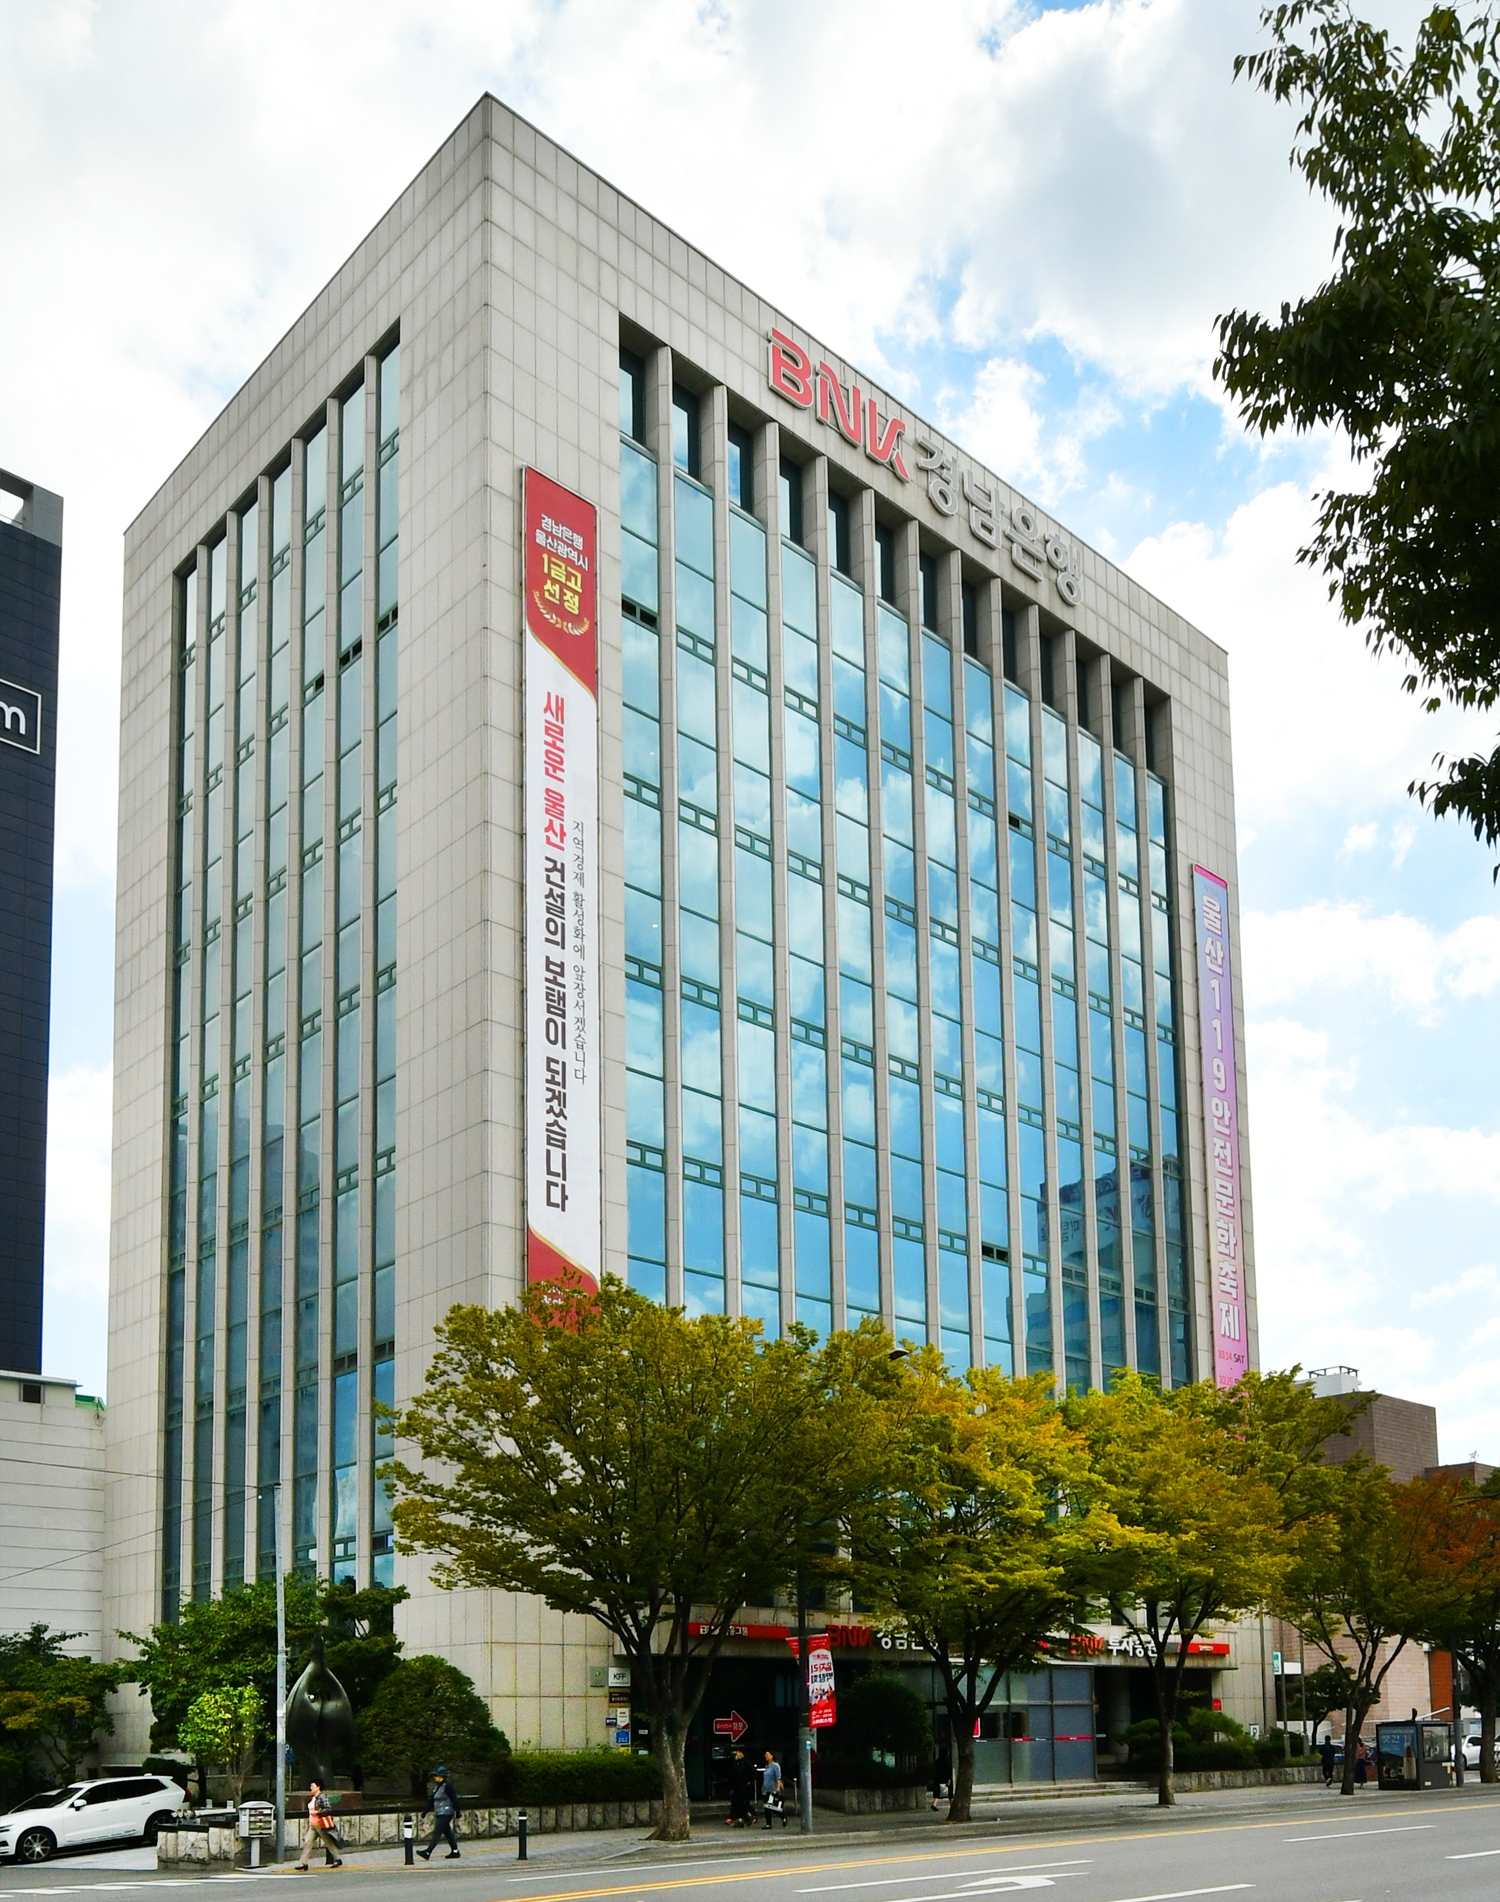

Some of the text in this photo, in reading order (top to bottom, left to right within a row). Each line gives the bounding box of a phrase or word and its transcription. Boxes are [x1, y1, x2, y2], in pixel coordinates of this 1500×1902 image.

[768, 327, 1083, 606] BNK 경남은행
[535, 529, 589, 571] 울산광역시
[541, 513, 583, 550] 경남은행
[542, 553, 583, 593] 1금고
[543, 690, 569, 1212] 새로운 울산 건설의 보탬이 되겠습니다
[572, 820, 587, 1085] 지역경제 활성화에 앞장서겠습니다
[1233, 1353, 1245, 1364] SAT
[826, 1624, 873, 1647] BNK
